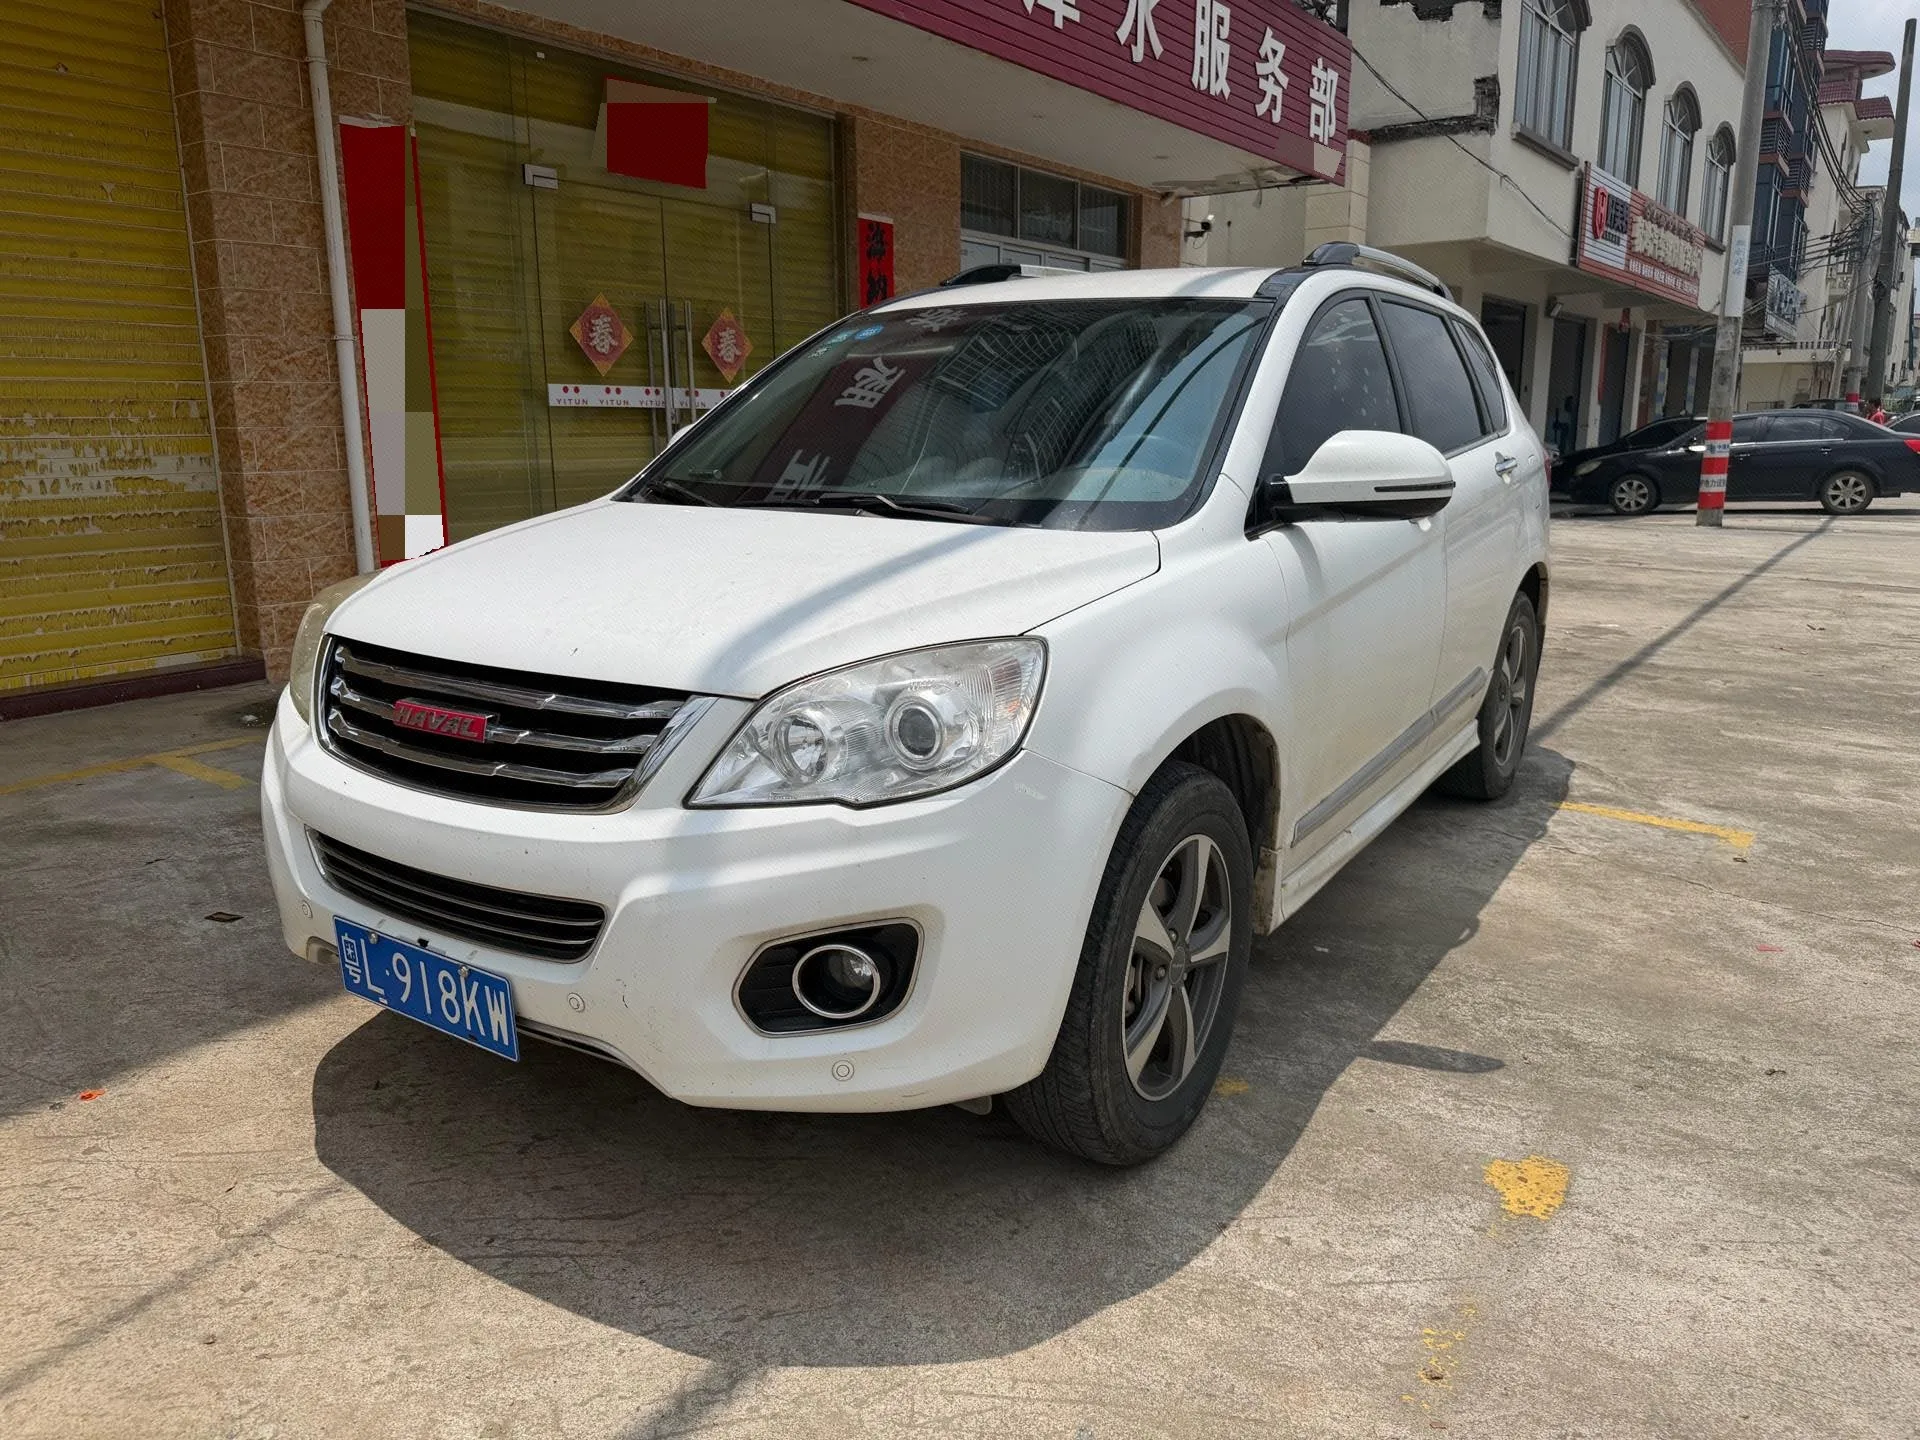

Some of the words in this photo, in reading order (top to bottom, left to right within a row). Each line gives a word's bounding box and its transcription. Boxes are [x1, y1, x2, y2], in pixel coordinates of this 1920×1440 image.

[589, 314, 618, 354] 春
[717, 328, 742, 363] 春
[396, 705, 479, 738] HAVAL
